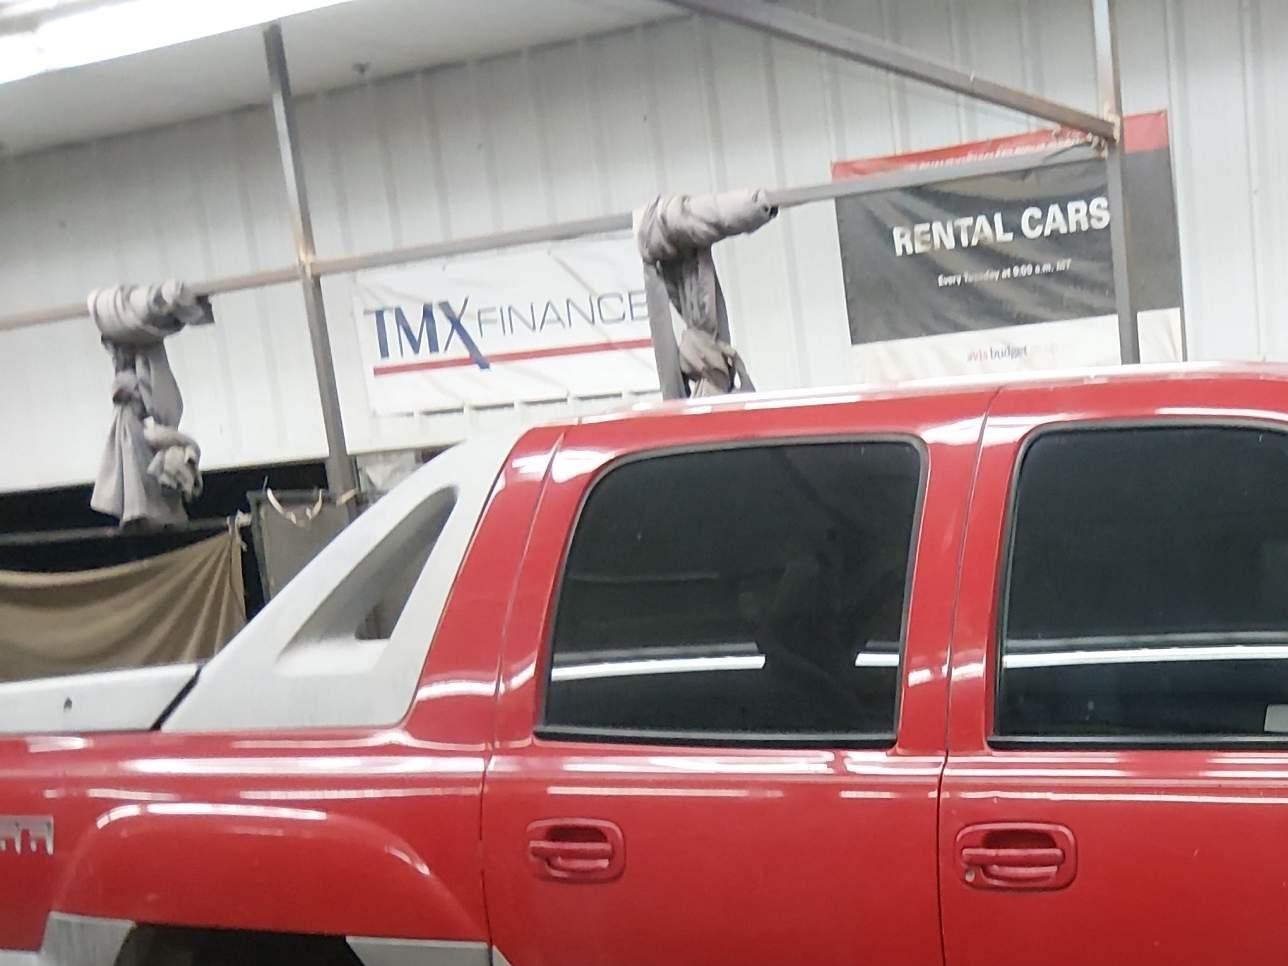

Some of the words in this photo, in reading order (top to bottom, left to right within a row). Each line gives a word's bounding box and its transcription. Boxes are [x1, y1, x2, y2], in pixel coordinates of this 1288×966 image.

[892, 212, 1014, 257] RENTAL
[1020, 196, 1111, 240] CARS
[937, 273, 962, 287] Every
[364, 296, 491, 371] TMX
[476, 289, 650, 338] FINANCE
